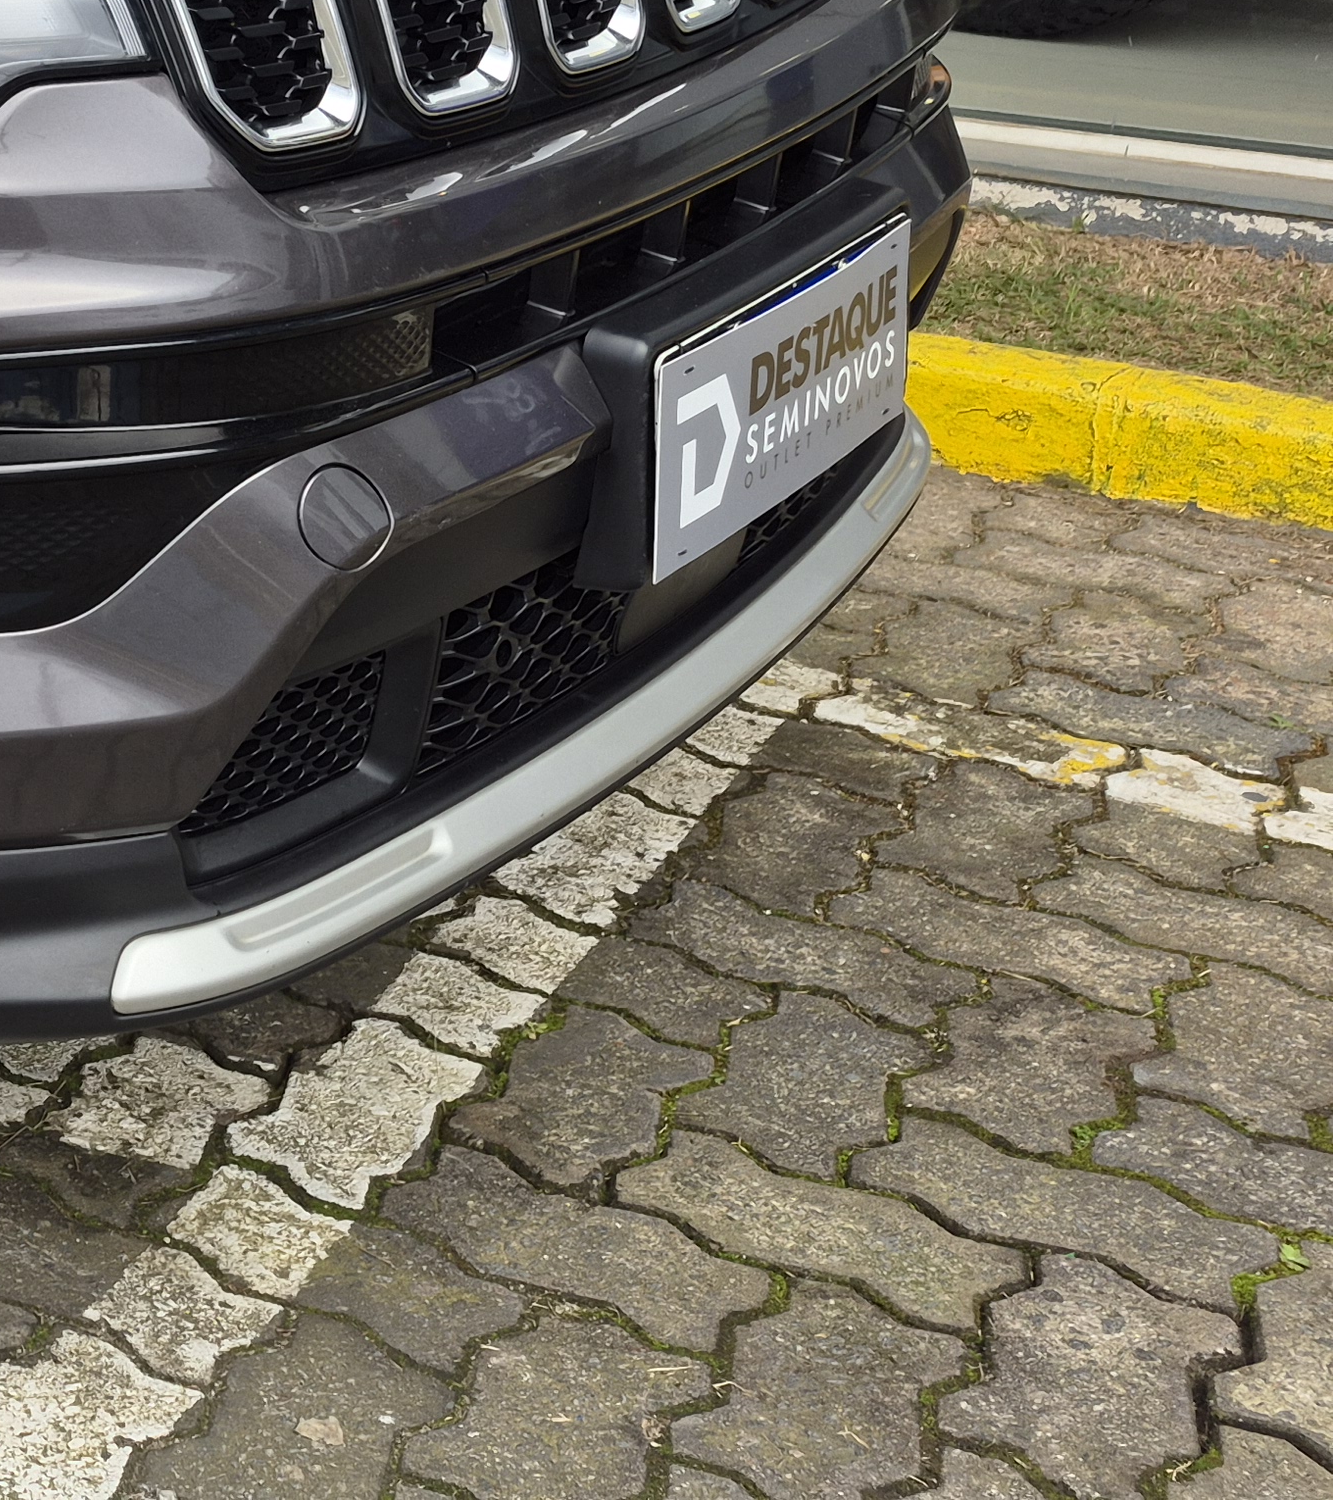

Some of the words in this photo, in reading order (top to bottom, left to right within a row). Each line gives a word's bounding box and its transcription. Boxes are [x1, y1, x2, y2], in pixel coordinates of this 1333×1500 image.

[744, 329, 896, 465] SEMINOVOS
[749, 265, 899, 417] DESTAQUE
[744, 431, 812, 490] OUTLET
[825, 374, 895, 436] PREMIUM
